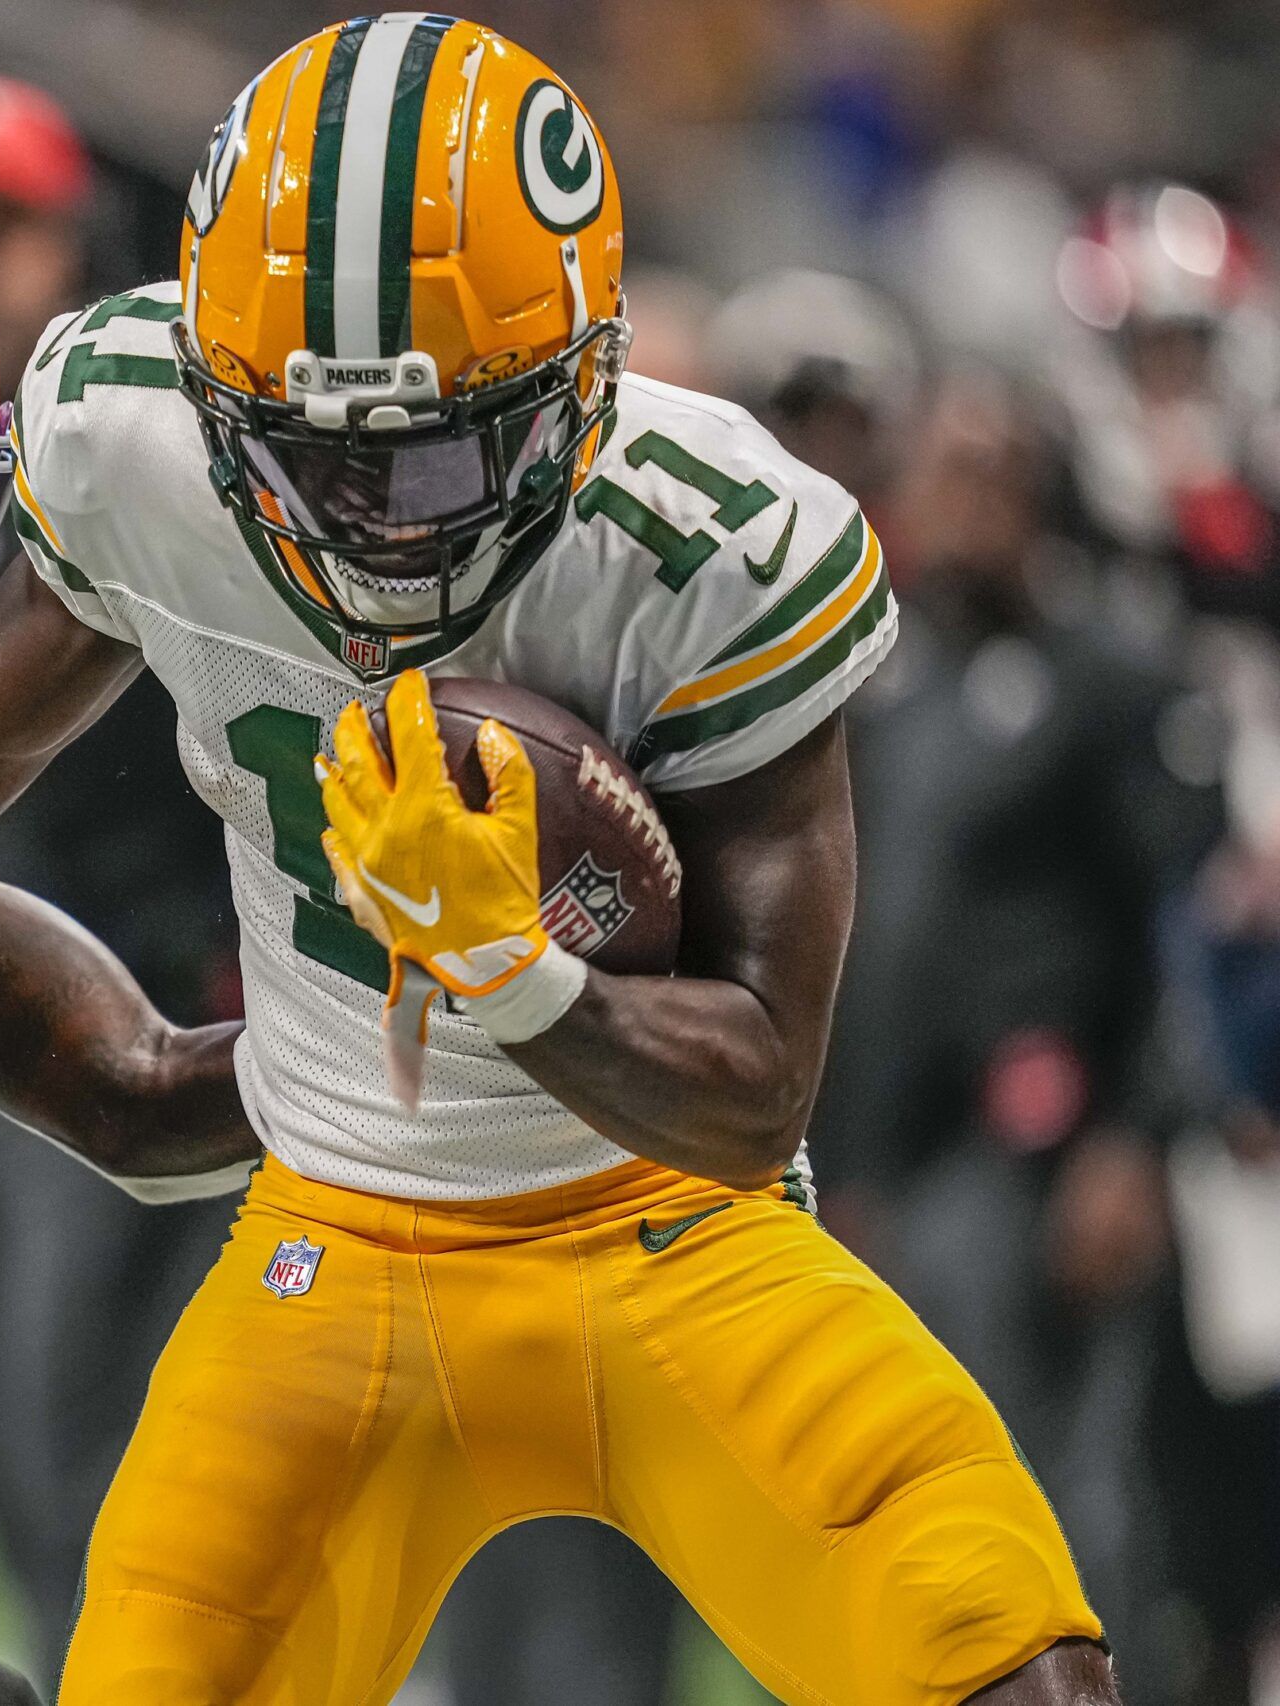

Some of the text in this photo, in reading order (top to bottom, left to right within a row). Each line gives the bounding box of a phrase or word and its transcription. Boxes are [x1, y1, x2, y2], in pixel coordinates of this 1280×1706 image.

[326, 367, 392, 385] PACKERS
[574, 429, 780, 595] 11
[347, 639, 382, 668] NFL
[271, 1261, 305, 1288] NFL
